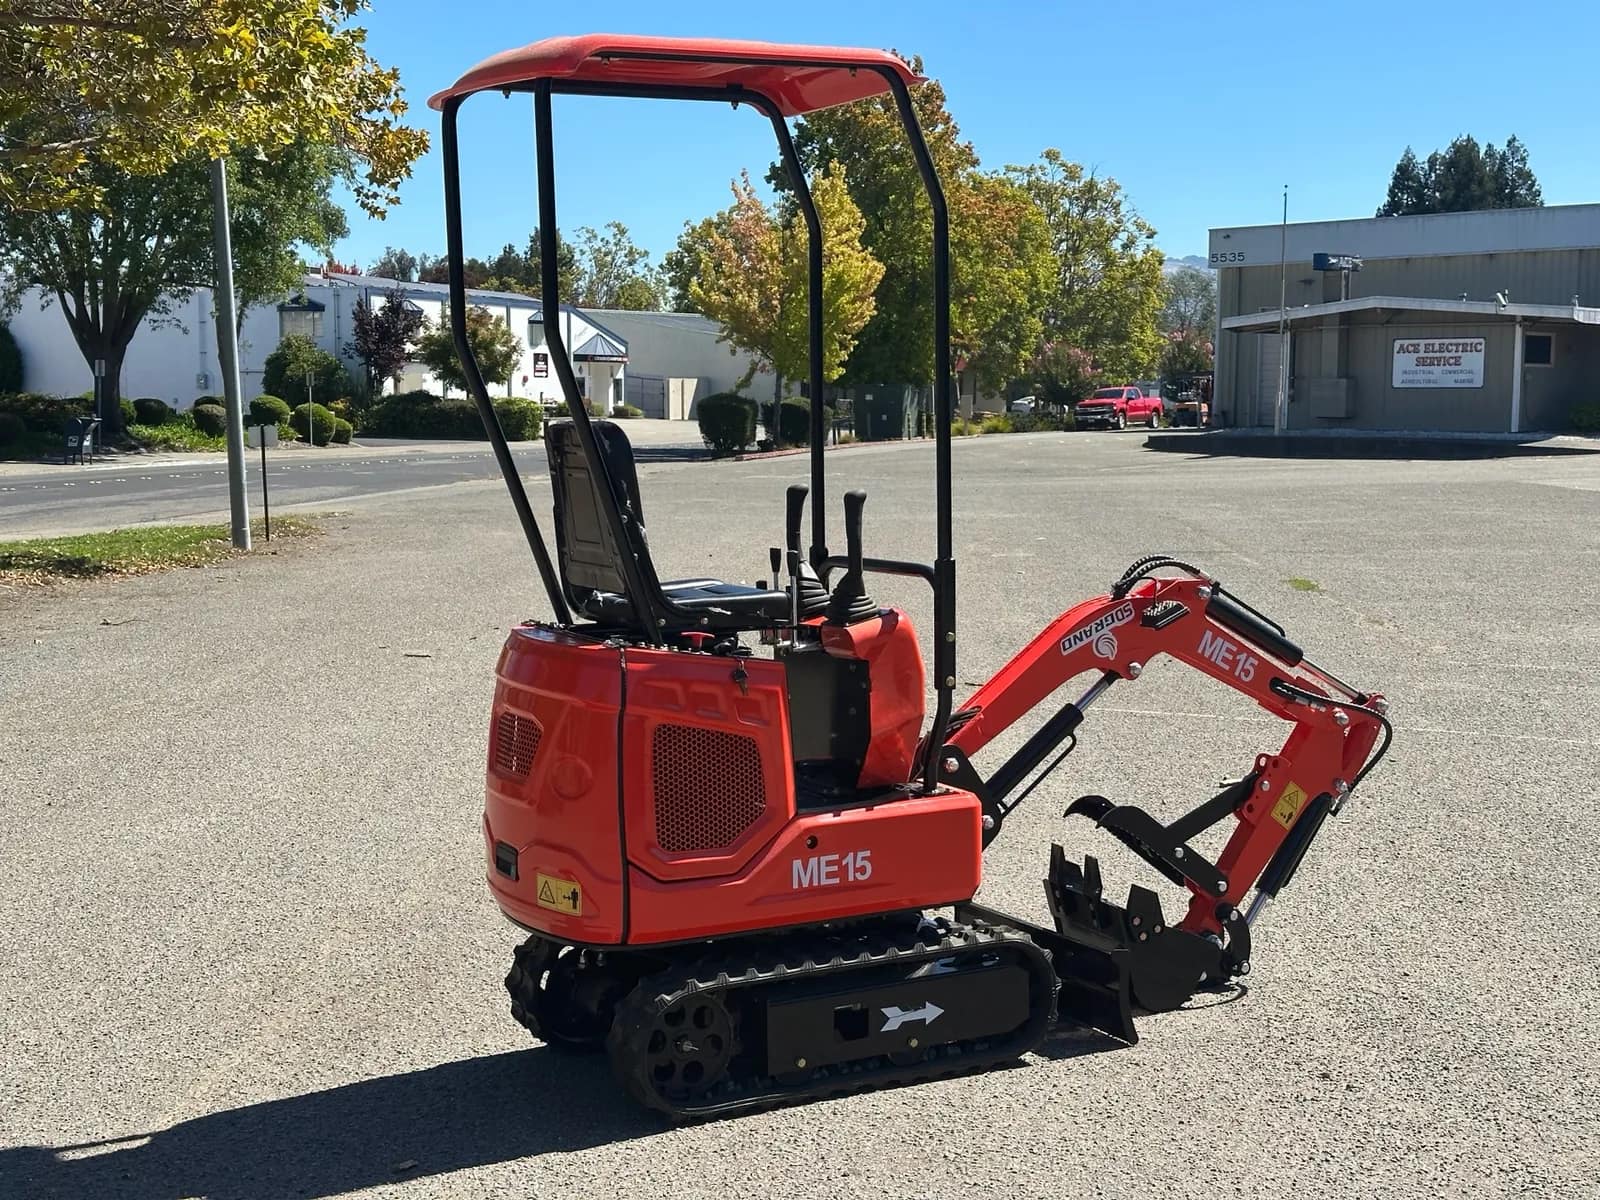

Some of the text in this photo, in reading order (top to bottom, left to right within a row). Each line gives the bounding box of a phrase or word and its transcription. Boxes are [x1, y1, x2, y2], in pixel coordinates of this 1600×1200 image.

[1211, 252, 1245, 263] 5535
[1396, 342, 1483, 354] ACE ELECTRIC
[1415, 356, 1462, 367] SERVICE
